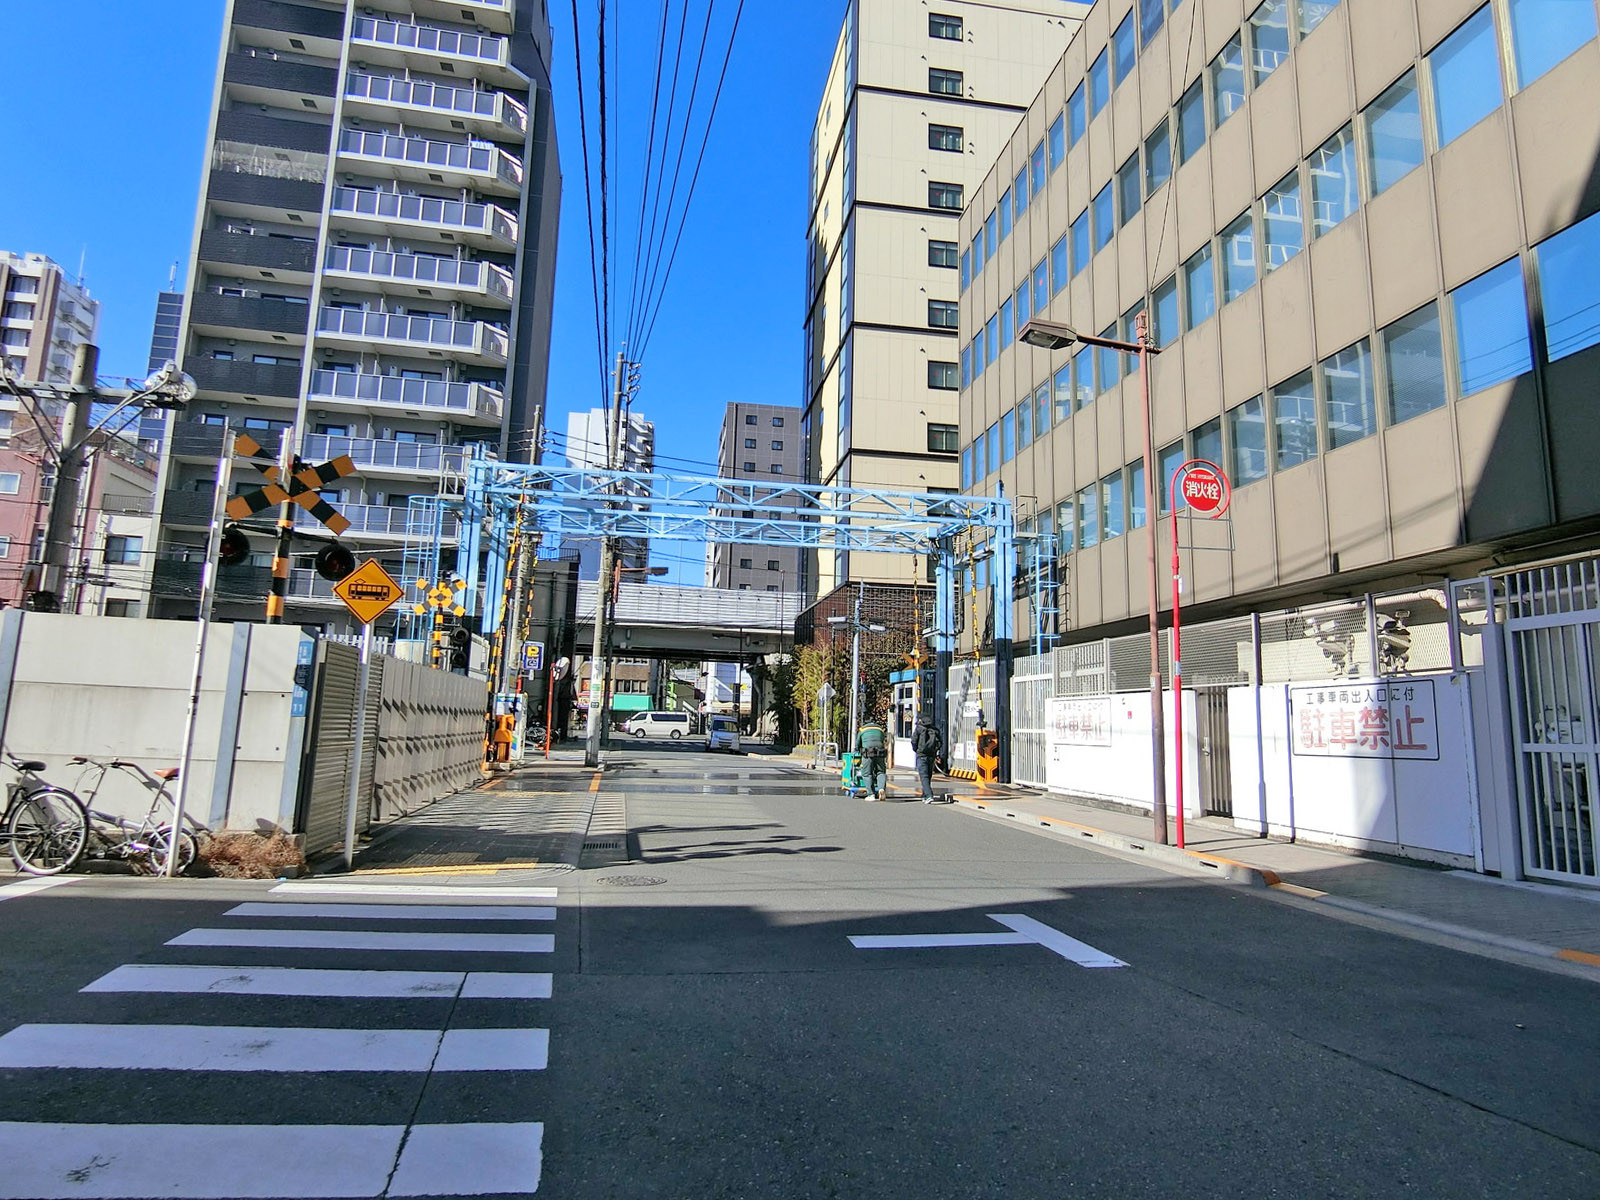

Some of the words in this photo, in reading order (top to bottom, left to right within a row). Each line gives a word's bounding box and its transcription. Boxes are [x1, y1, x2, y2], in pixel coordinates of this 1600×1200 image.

[1185, 481, 1219, 500] 消火栓
[1306, 687, 1414, 705] 工事車両出入口に付
[1300, 705, 1428, 750] 駐車禁止
